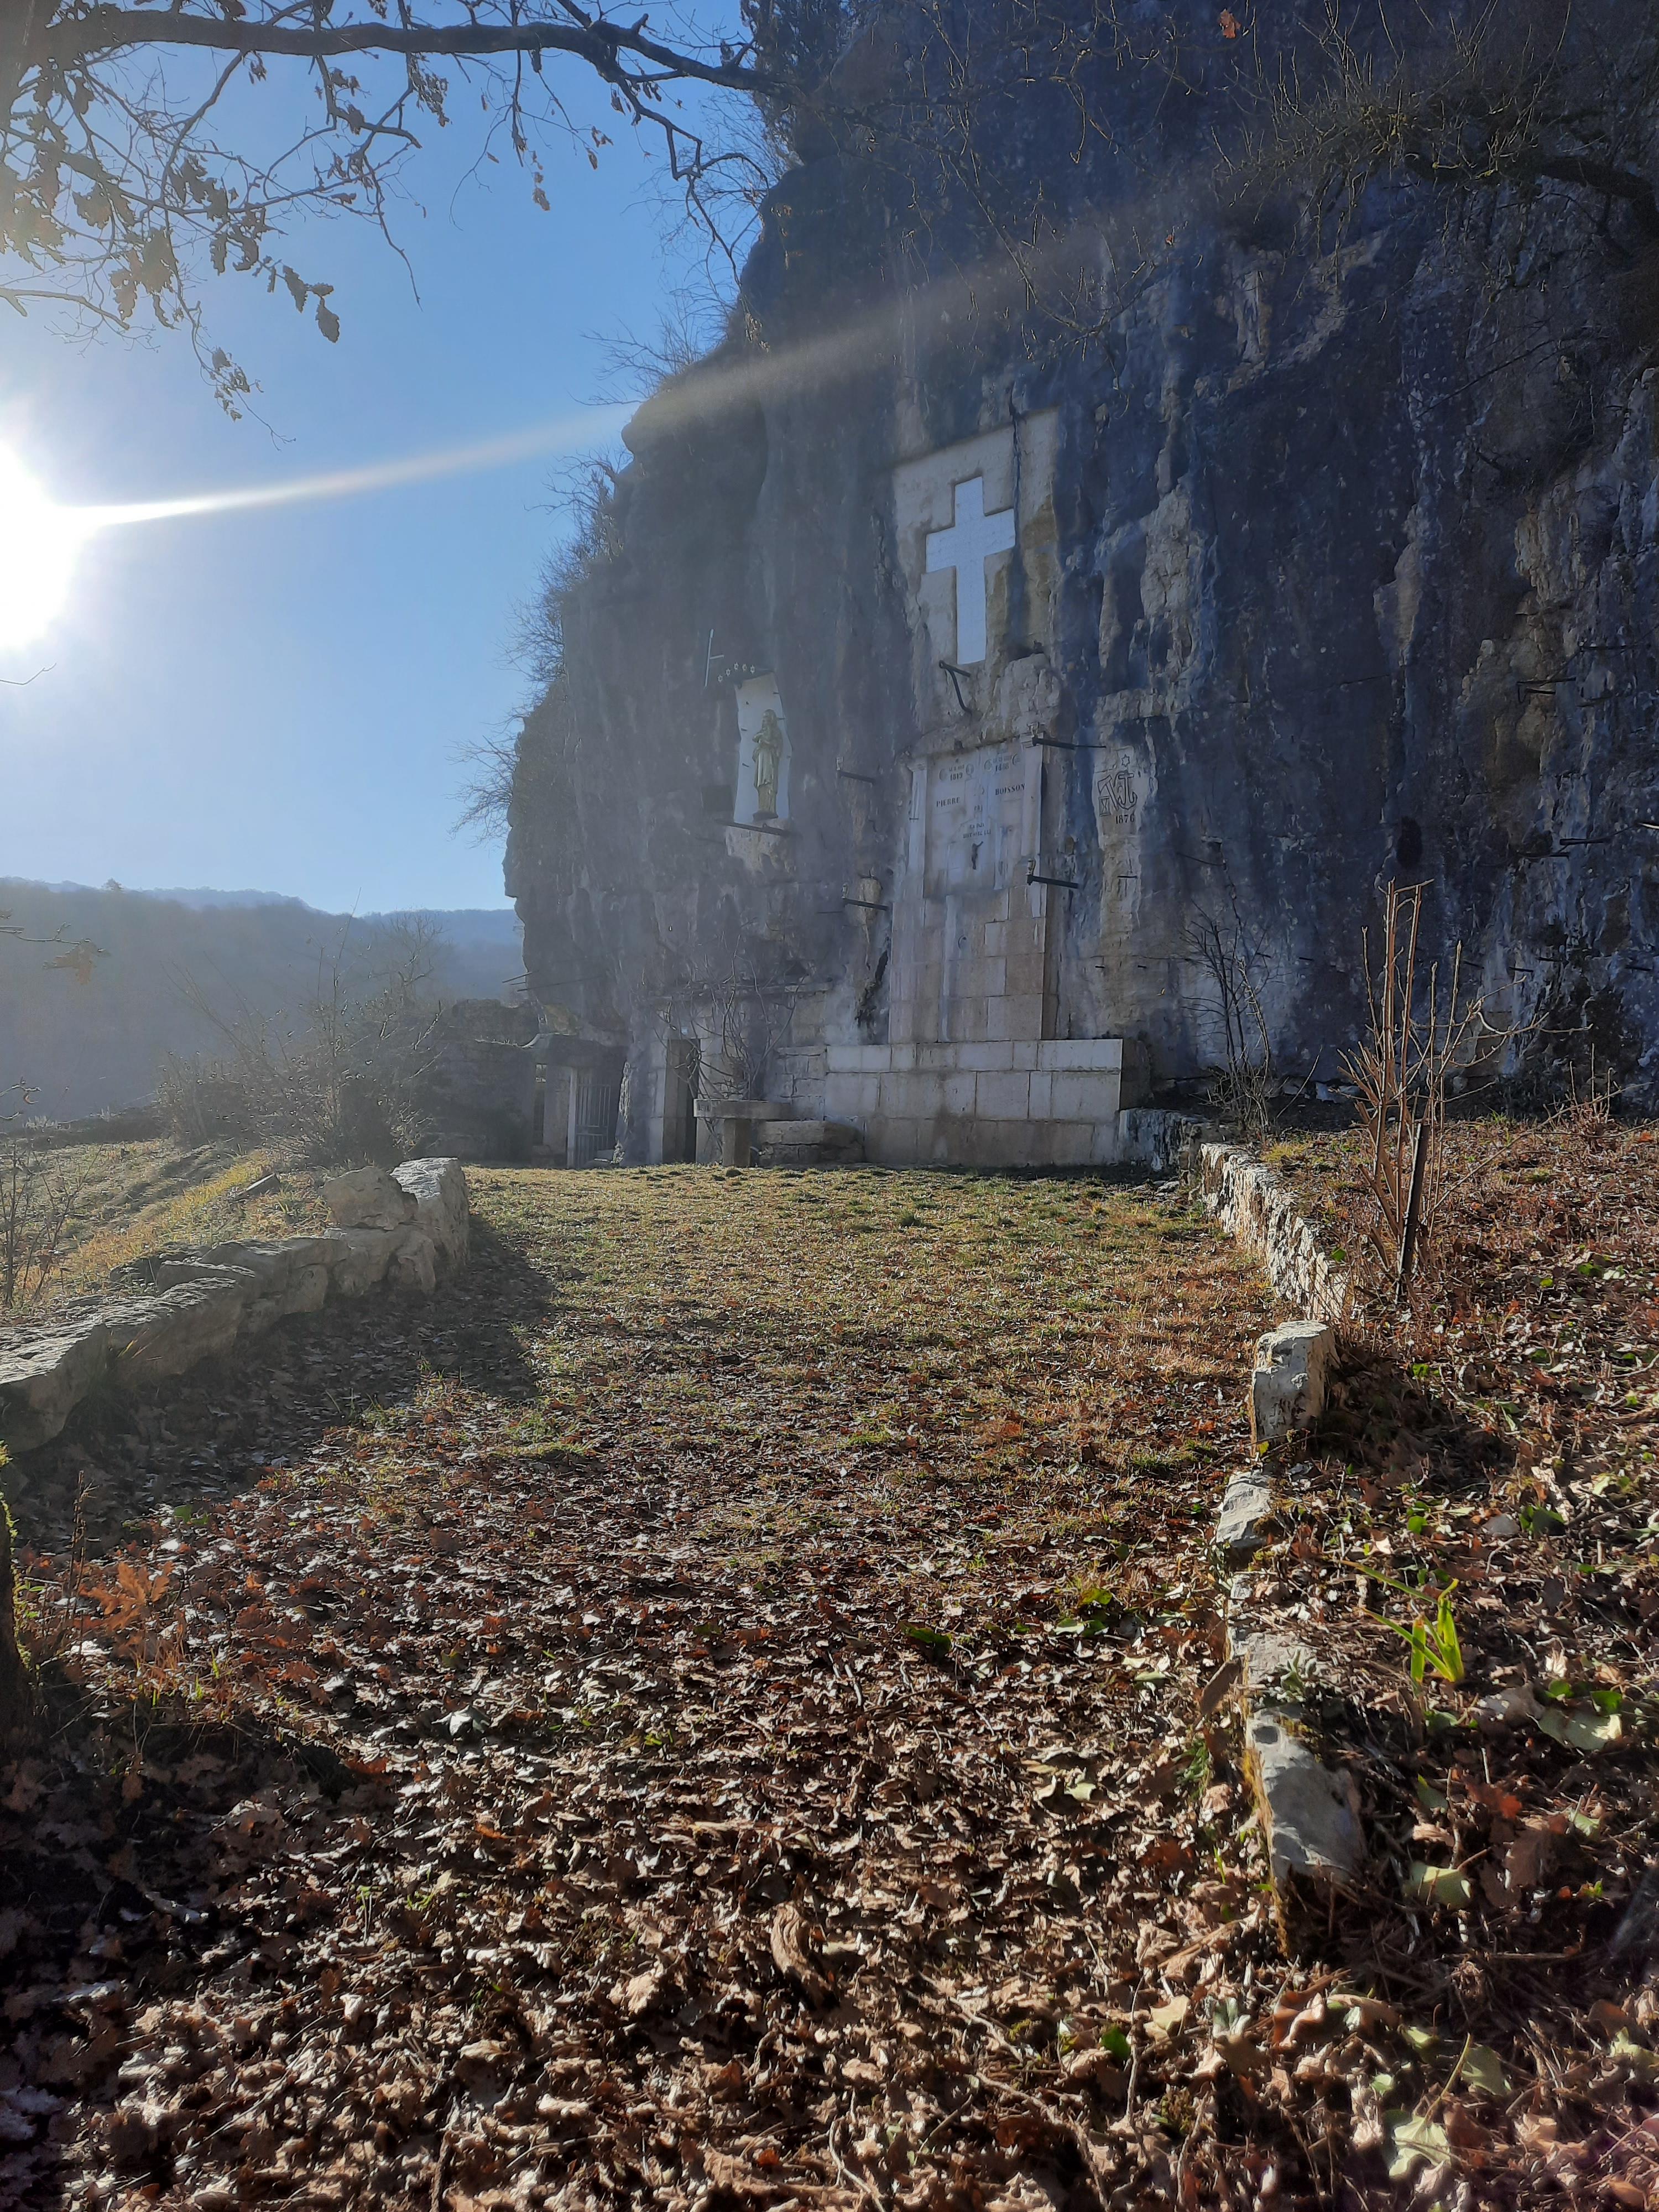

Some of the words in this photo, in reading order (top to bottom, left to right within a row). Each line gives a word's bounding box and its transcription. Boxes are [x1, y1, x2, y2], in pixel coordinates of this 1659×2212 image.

[936, 797, 960, 807] PIERRE
[995, 783, 1025, 795] BOISSON
[1115, 813, 1134, 824] 1876
